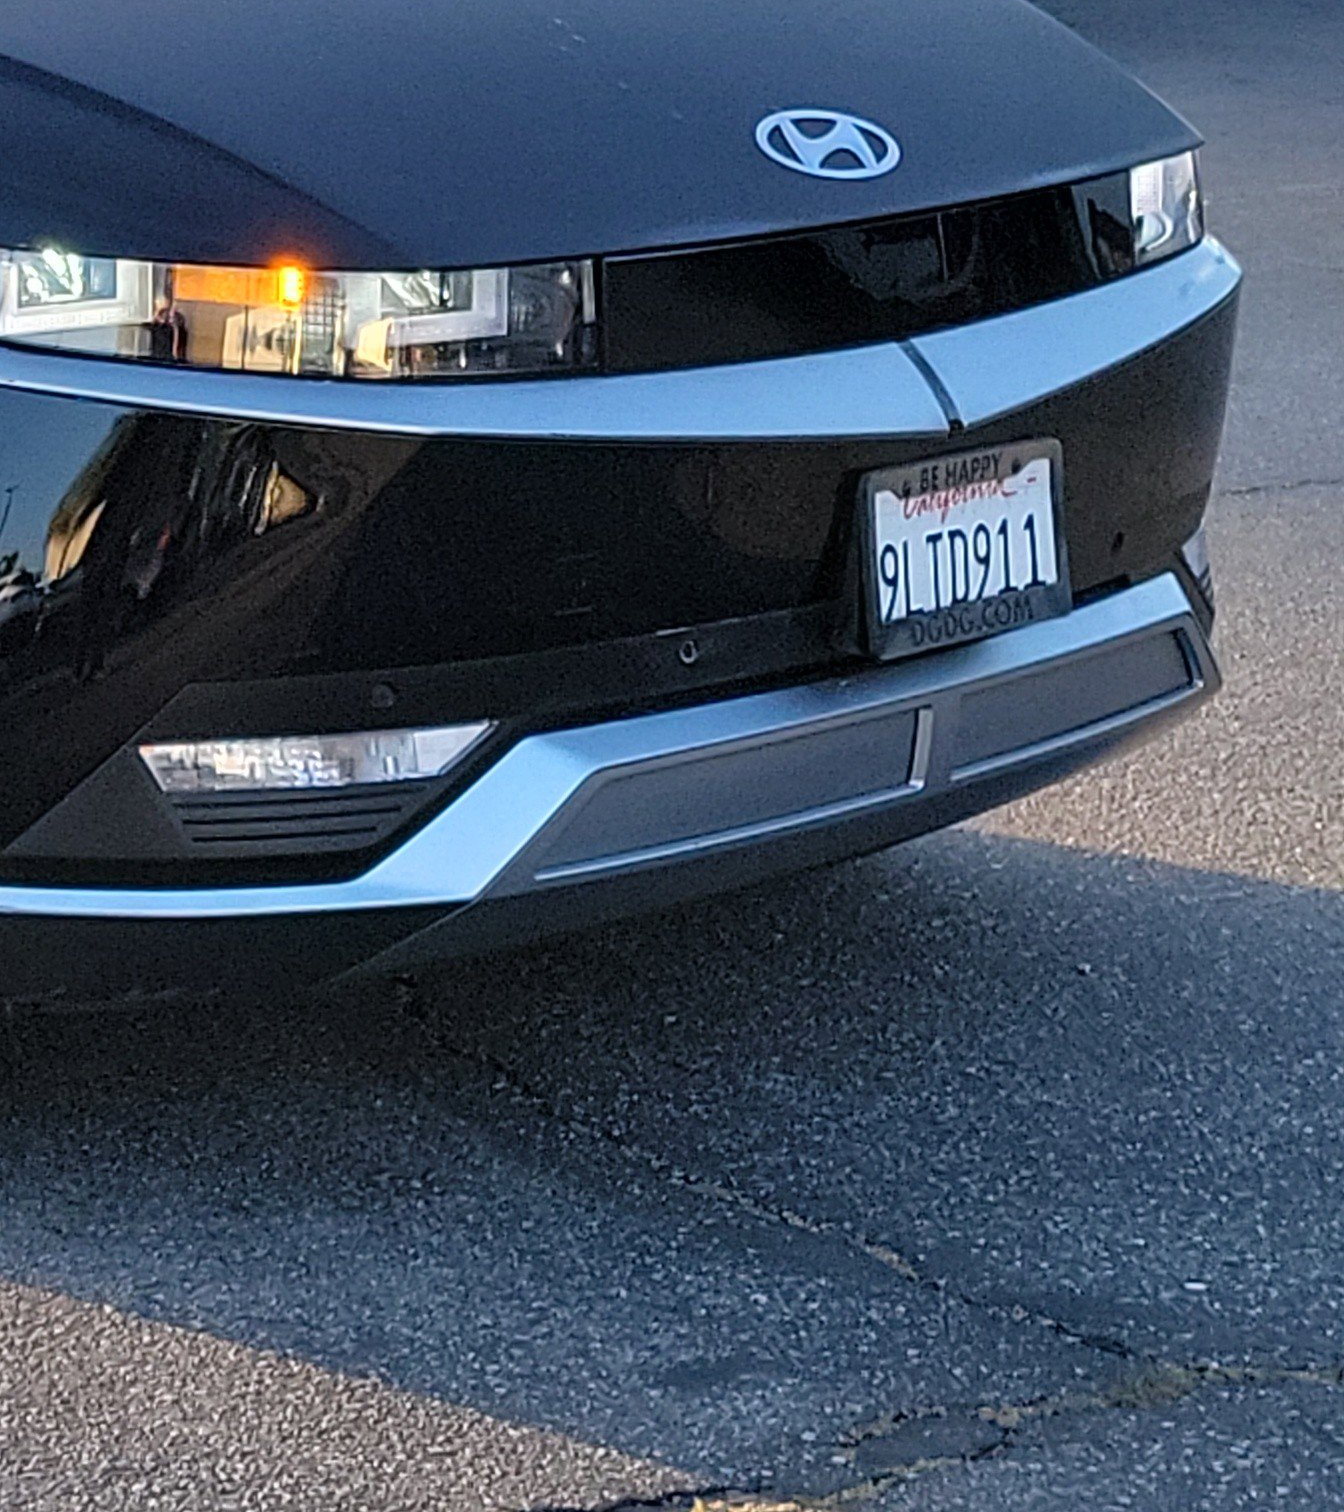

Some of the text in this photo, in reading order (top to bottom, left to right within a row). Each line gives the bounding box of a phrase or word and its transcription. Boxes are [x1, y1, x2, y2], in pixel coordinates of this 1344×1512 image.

[920, 453, 1005, 491] BE HAPPY
[879, 512, 1048, 623] 9LTD911
[912, 594, 1036, 647] DGDG.COM
